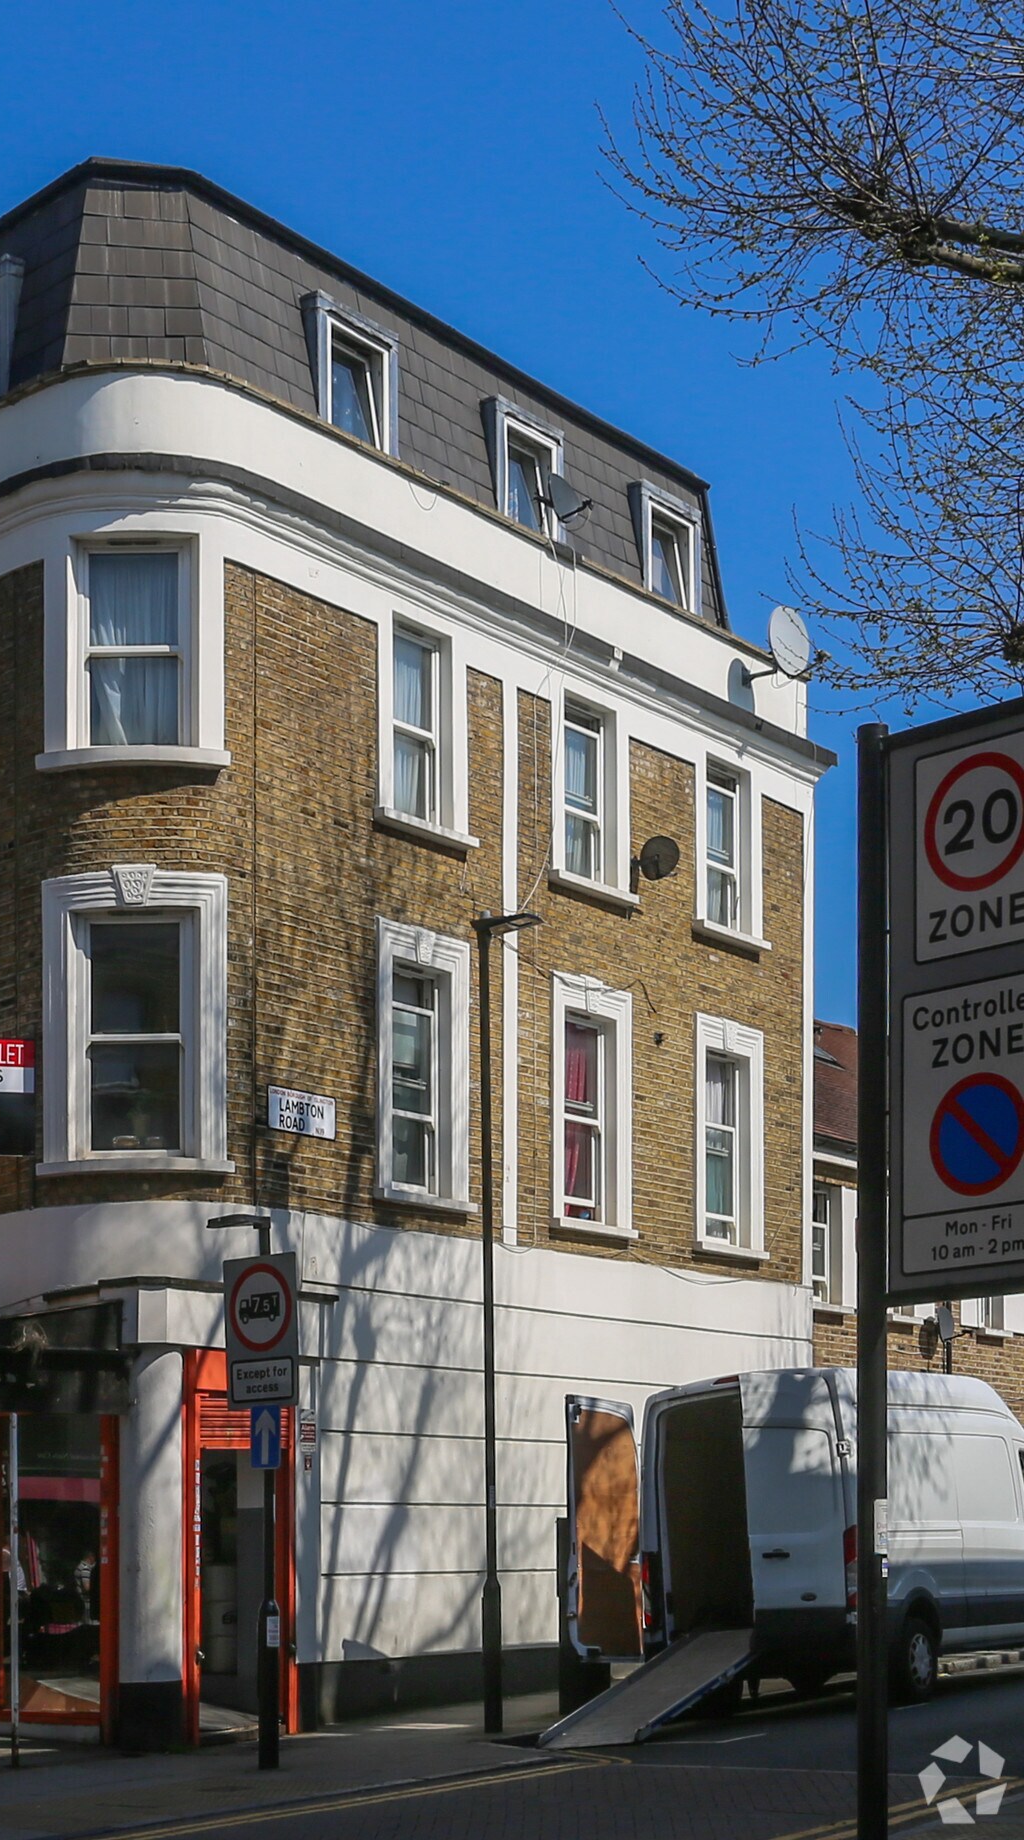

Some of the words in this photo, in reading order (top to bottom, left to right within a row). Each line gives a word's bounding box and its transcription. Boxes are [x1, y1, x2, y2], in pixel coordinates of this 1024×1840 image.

[943, 788, 1018, 856] 20
[928, 891, 1024, 943] ZONE
[912, 988, 1024, 1031] Controlle
[931, 1023, 1024, 1068] ZONE
[279, 1097, 324, 1119] LAMBTON
[279, 1114, 305, 1132] ROAD
[945, 1220, 978, 1237] Mon
[991, 1213, 1012, 1231] Fri
[931, 1244, 949, 1261] 10
[952, 1245, 975, 1259] am
[988, 1238, 998, 1254] 2
[236, 1367, 271, 1381] Except
[273, 1366, 288, 1378] for
[245, 1383, 279, 1394] access
